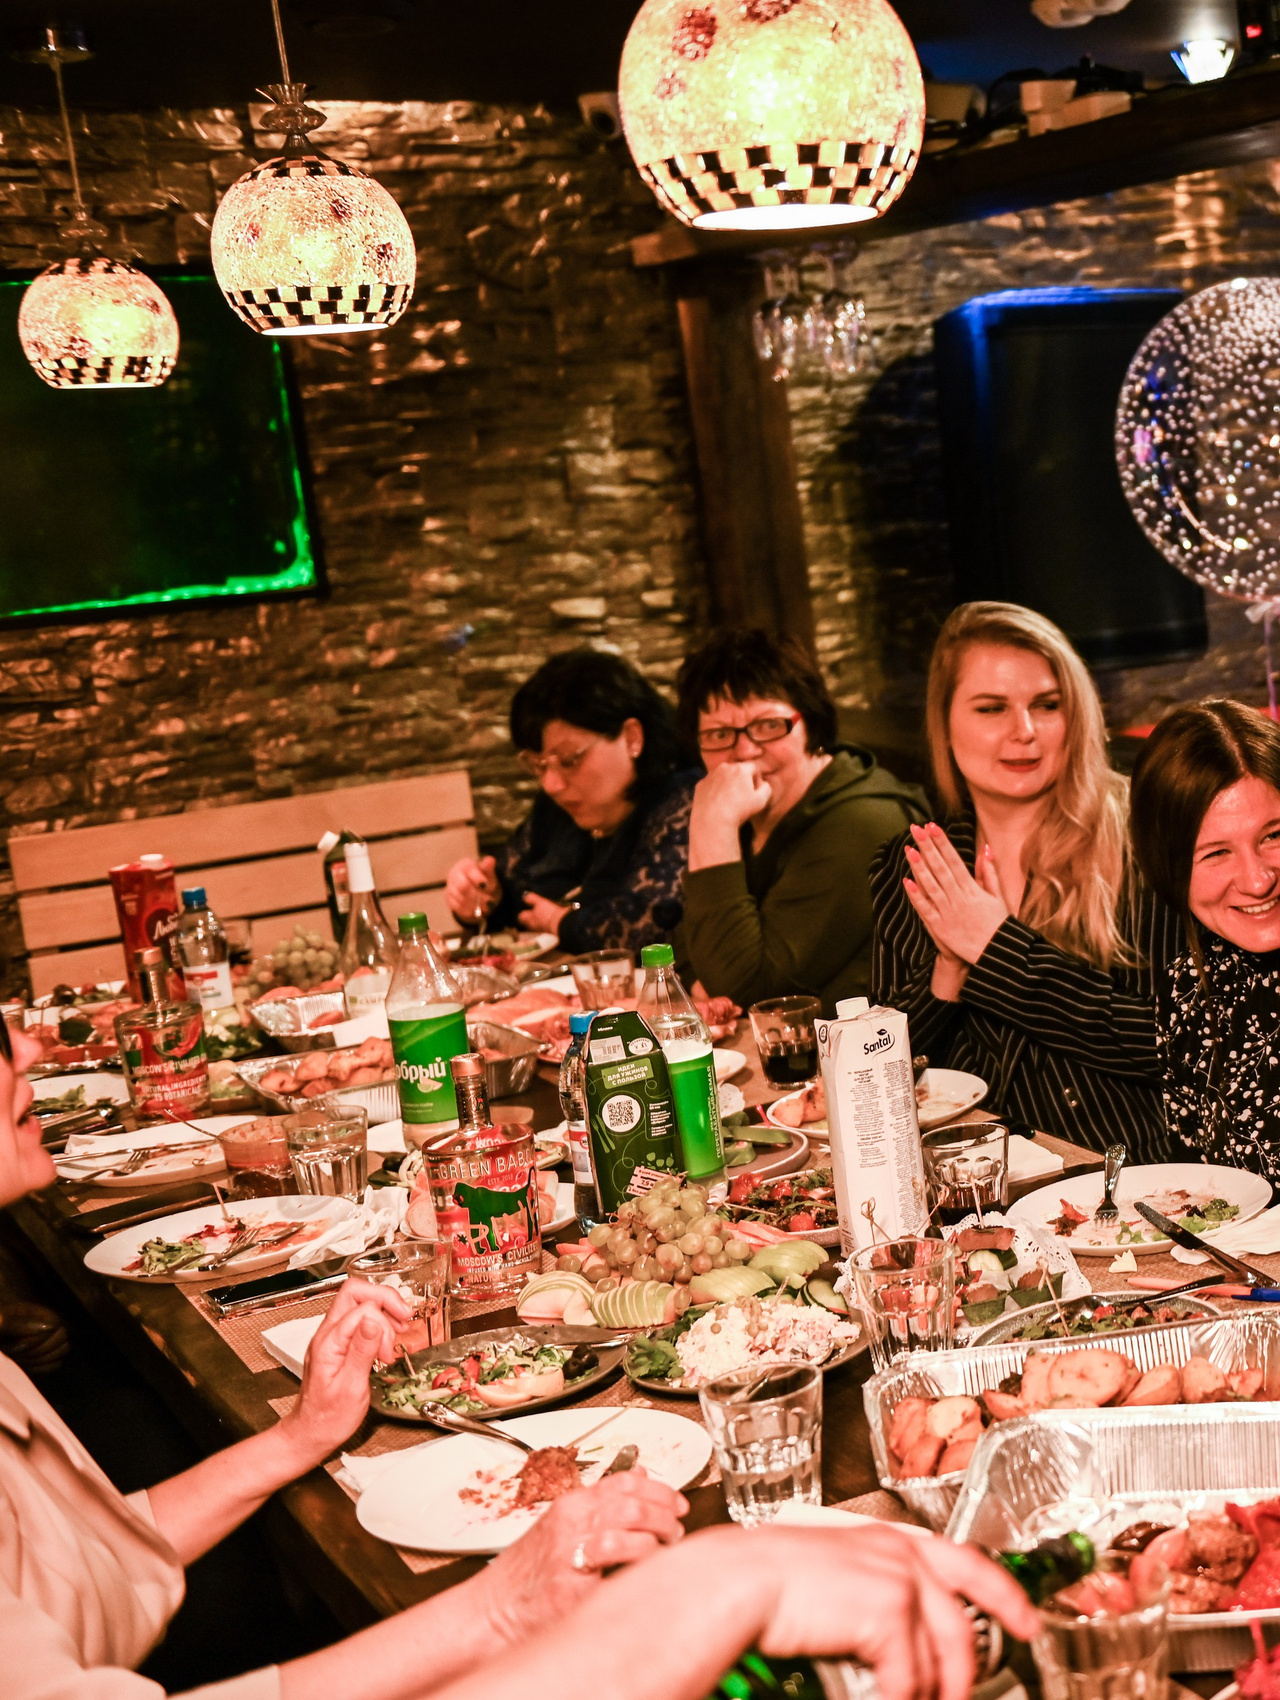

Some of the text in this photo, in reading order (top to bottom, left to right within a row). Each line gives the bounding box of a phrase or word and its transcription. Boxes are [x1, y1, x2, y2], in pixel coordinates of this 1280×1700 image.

[863, 1034, 891, 1055] Santal
[395, 1057, 446, 1083] обрый
[607, 1066, 648, 1082] ДЛЯ УЖИНОВ
[617, 1063, 635, 1072] ИДЕИ
[617, 1073, 647, 1084] ПОЛЬЗОЙ
[439, 1149, 533, 1179] GREEN BABO
[458, 1254, 503, 1266] MOSCOW'S
[506, 1243, 537, 1260] CIVILIZE
